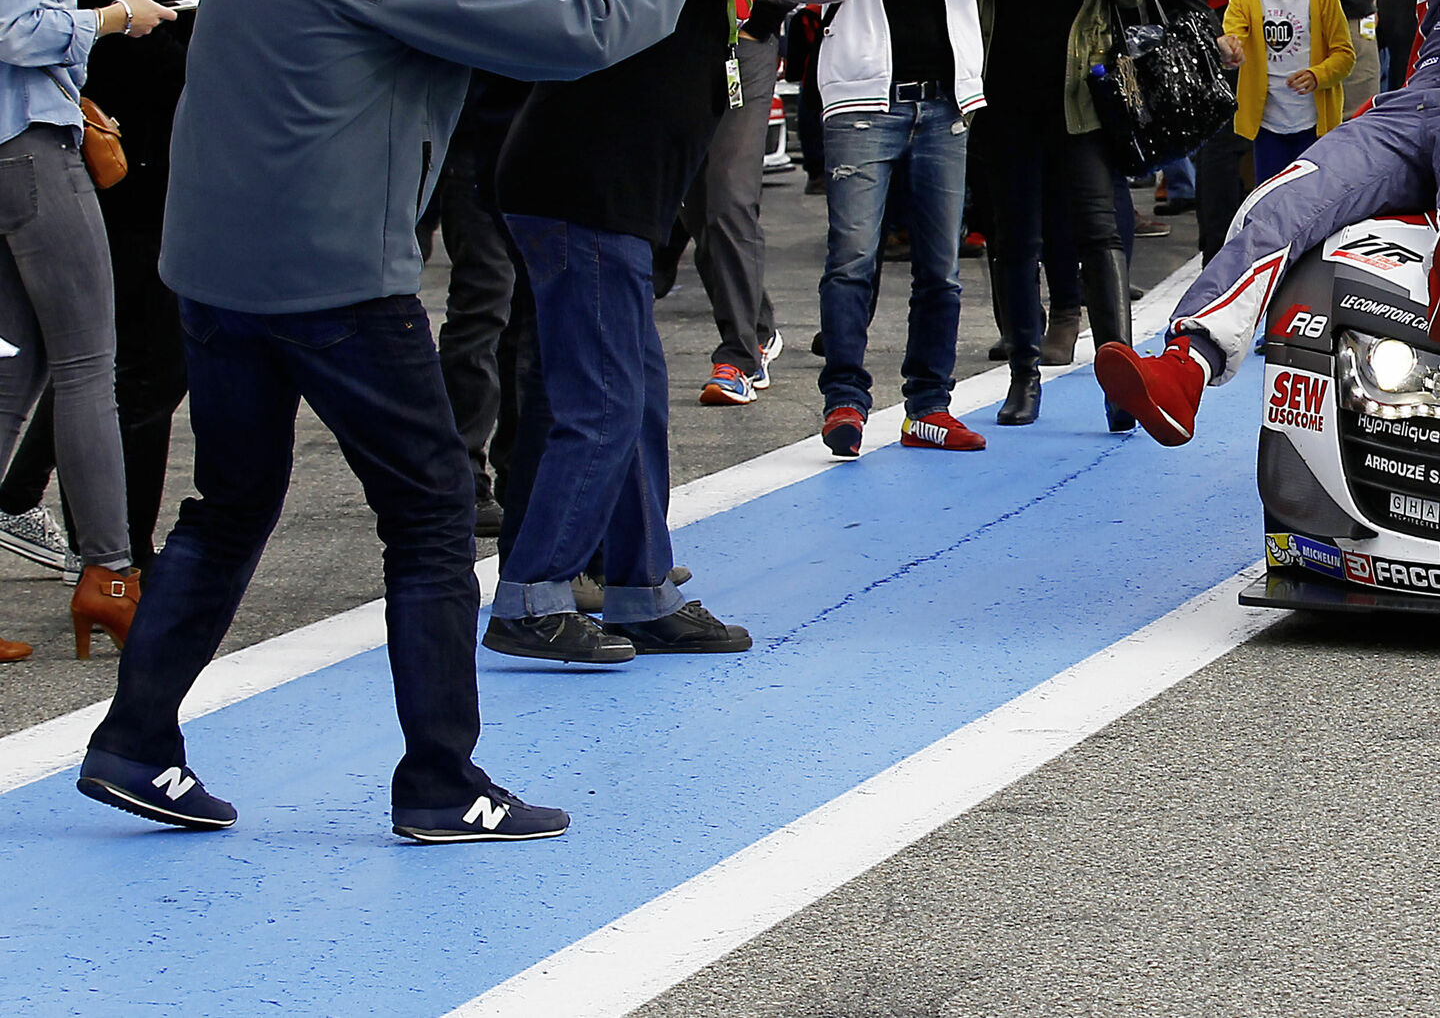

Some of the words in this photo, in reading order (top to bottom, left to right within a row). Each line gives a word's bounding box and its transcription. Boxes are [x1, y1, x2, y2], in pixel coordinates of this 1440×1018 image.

[1265, 26, 1291, 42] COOL
[1286, 312, 1328, 339] R8
[1270, 370, 1329, 415] SEW
[908, 420, 949, 446] PUMA
[1268, 407, 1324, 433] USOCOME
[1358, 413, 1440, 444] Hypnelique
[1364, 453, 1426, 481] ARROUZÉ
[1302, 545, 1341, 567] MICHELIN
